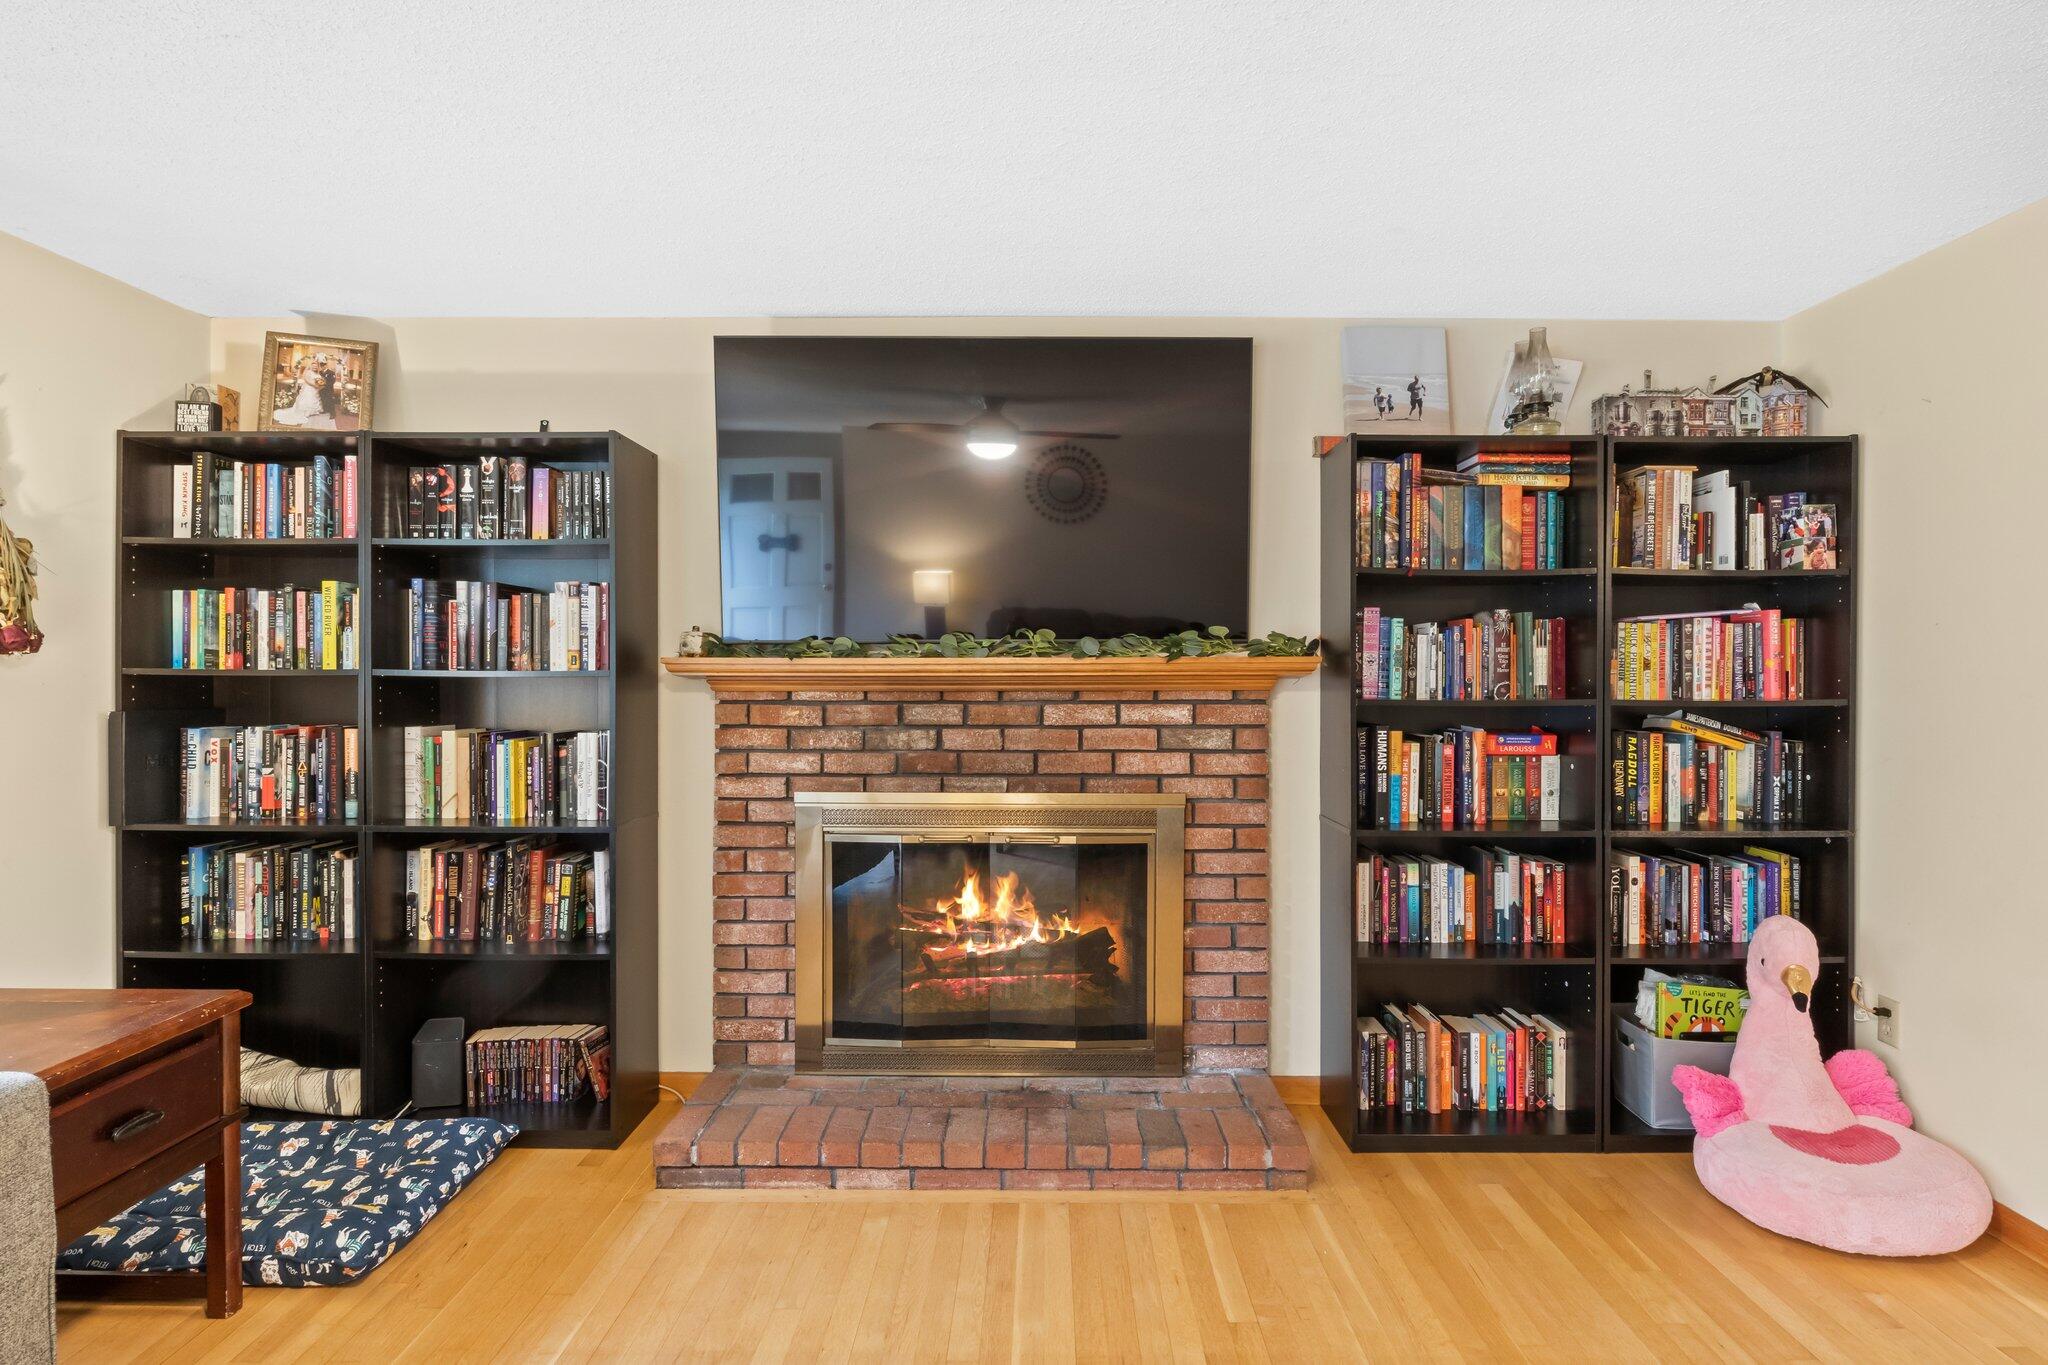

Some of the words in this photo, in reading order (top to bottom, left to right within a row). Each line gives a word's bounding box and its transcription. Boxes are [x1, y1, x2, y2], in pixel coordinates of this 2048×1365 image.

[1630, 622, 1638, 648] CHUCK
[1630, 652, 1638, 700] PALAHNIUK
[1736, 657, 1744, 690] PALAHNIUK
[1680, 724, 1698, 734] LAND
[1723, 724, 1742, 736] DOUBLE
[188, 744, 196, 770] CHILD
[248, 737, 256, 768] CUTTING
[1378, 731, 1387, 772] HUMANS
[1628, 736, 1637, 788] RAGDOLL
[248, 770, 256, 788] EDGE
[1360, 772, 1366, 784] ME
[1614, 760, 1624, 797] LEGENDARY
[1611, 868, 1620, 894] YOU
[181, 886, 190, 908] MENTOR
[1680, 998, 1735, 1018] TIGER
[1498, 1049, 1506, 1072] LIES
[170, 1205, 191, 1213] FETCH!
[313, 1198, 334, 1207] FETCH!
[362, 1216, 376, 1225] STAY
[243, 1244, 266, 1252] FETCH!
[314, 1238, 324, 1248] SIT
[86, 1259, 110, 1269] FETCH!
